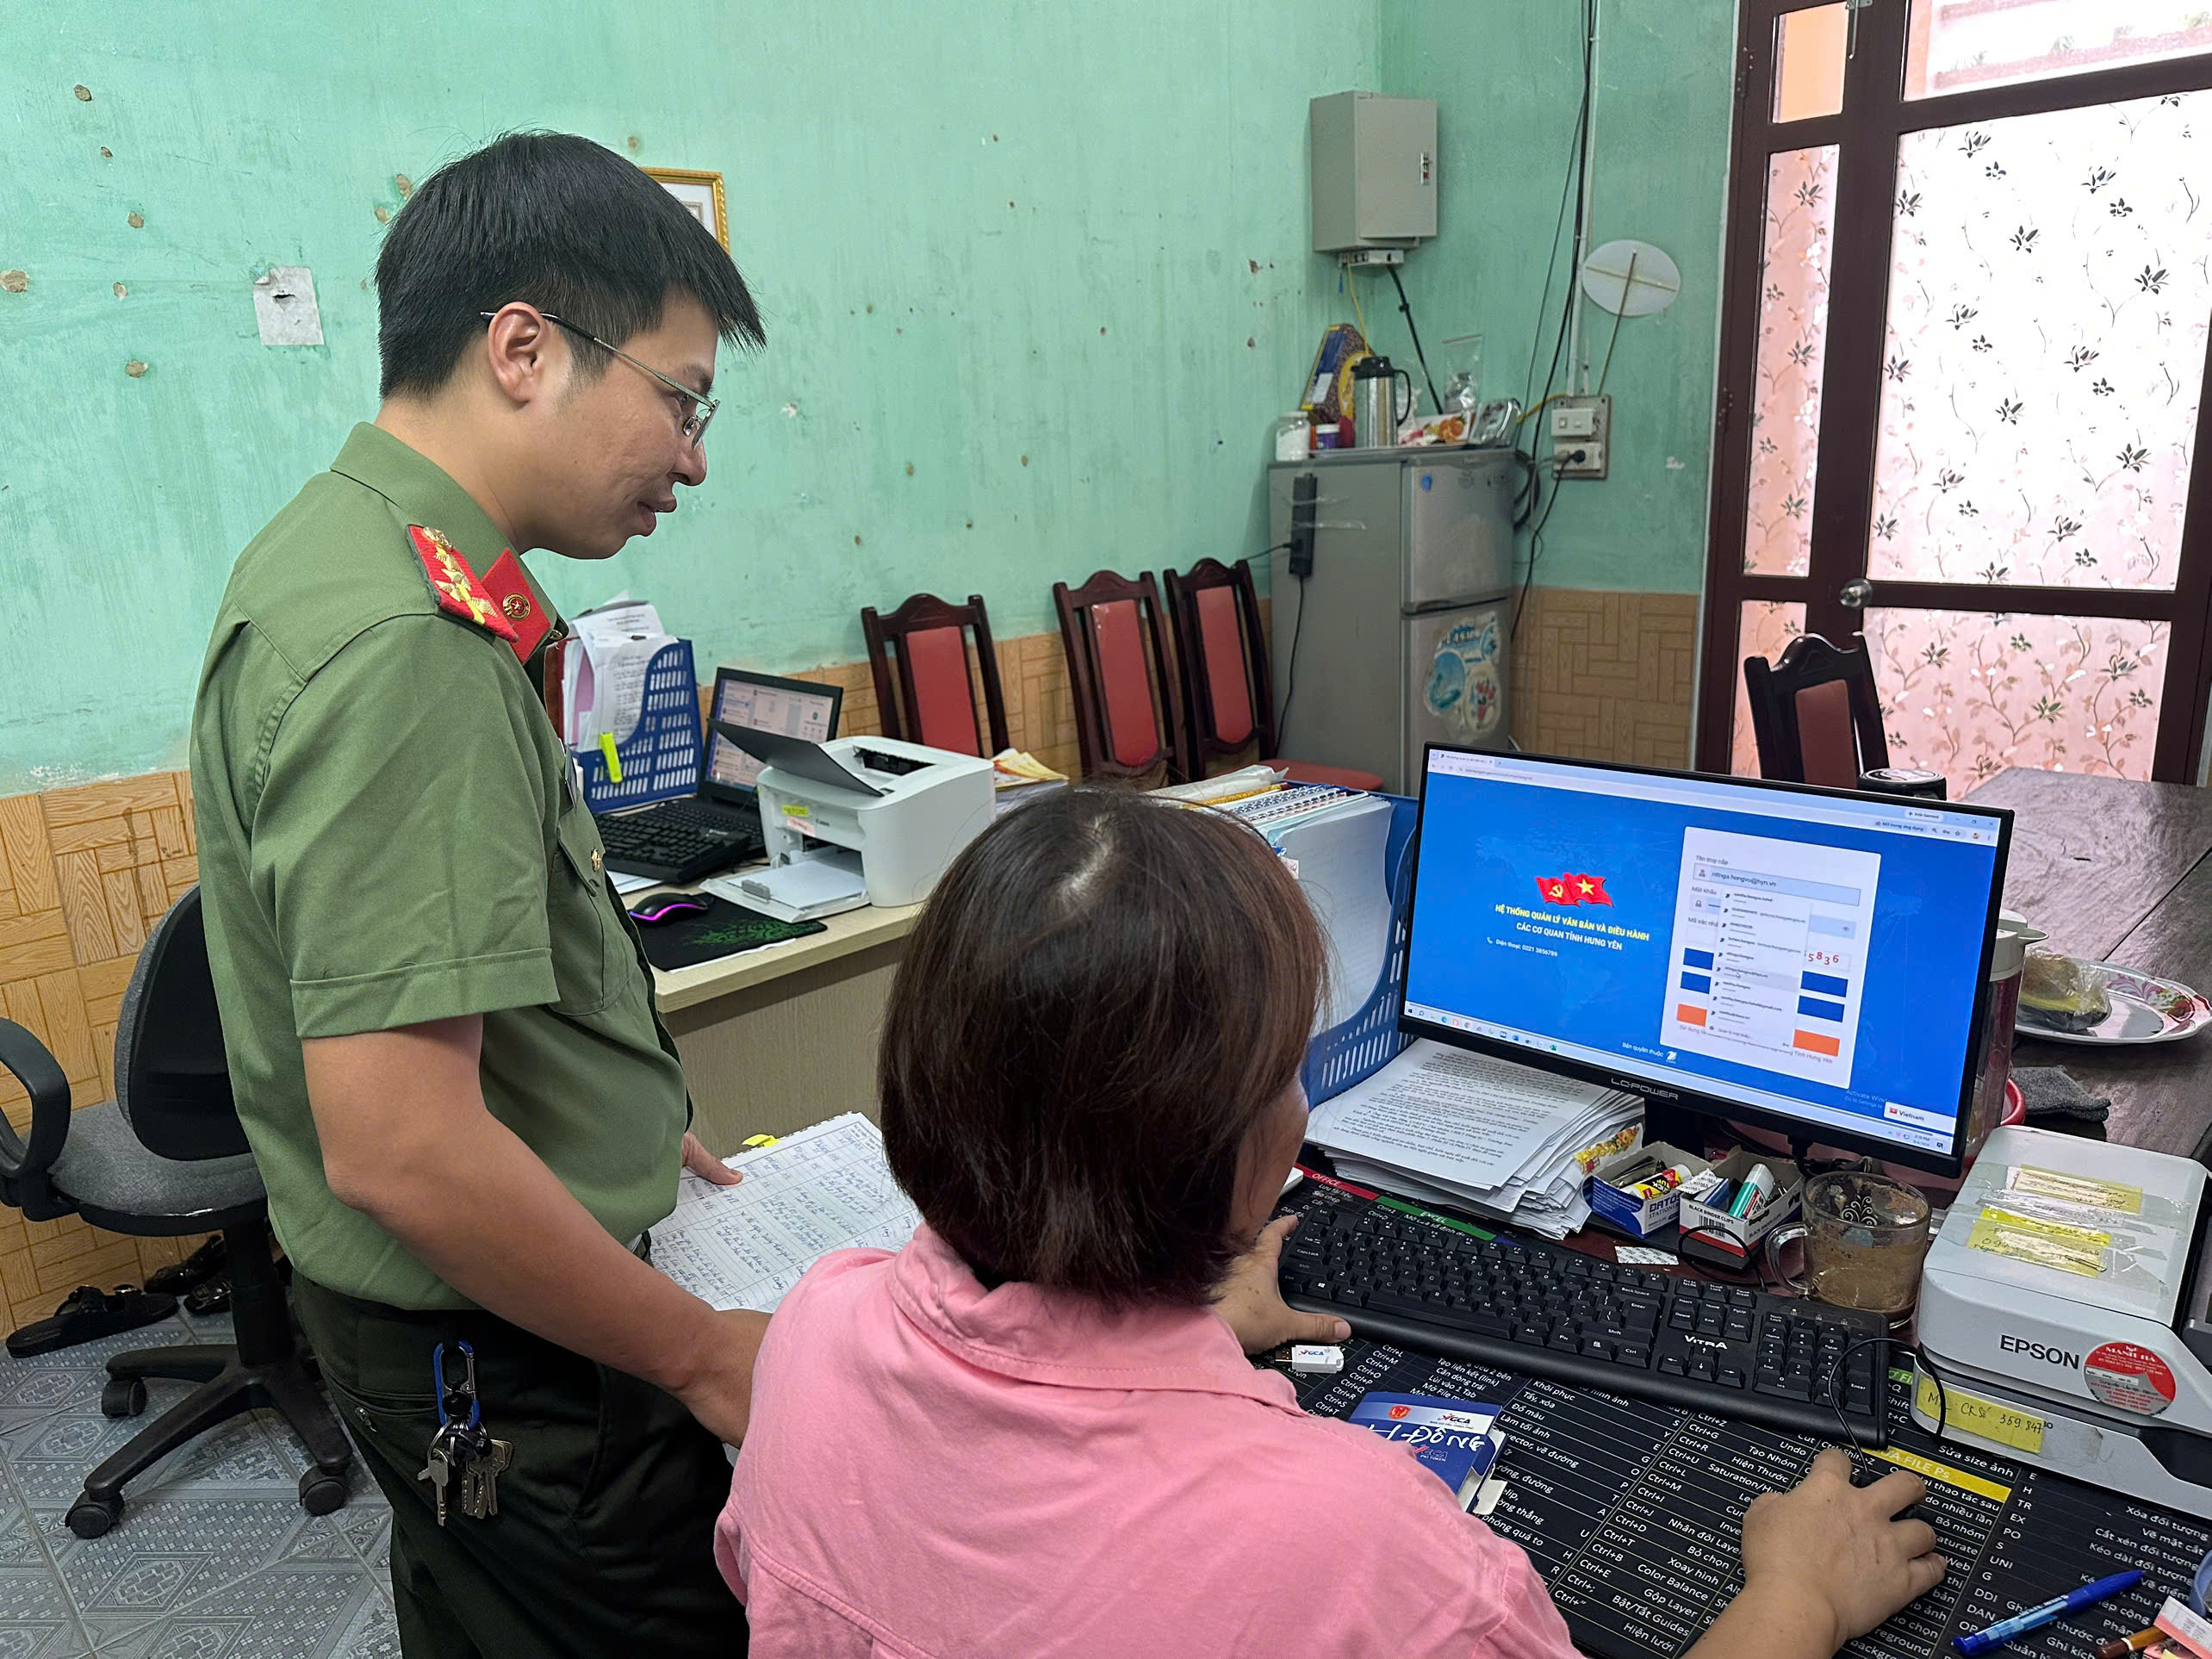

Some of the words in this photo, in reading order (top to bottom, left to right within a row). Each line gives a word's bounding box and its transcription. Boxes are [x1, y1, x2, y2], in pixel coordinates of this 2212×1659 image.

[1507, 905, 1531, 918] THỐNG
[1552, 914, 1561, 924] LÝ
[1562, 916, 1578, 928] VĂN
[1596, 922, 1606, 933] VÀ
[1626, 928, 1650, 941] HÀNH
[1516, 921, 1532, 932] CÁC
[1544, 928, 1564, 940] QUAN
[1583, 935, 1606, 948] HƯNG
[1607, 939, 1623, 951] YÊN
[1898, 1109, 1924, 1122] Vietnam
[1311, 1172, 1343, 1187] OFFICE
[1420, 1210, 1446, 1224] EXCEL
[1372, 1350, 1399, 1365] Ctrl+M
[1382, 1344, 1404, 1358] Ctrl+L
[1998, 1333, 2081, 1371] EPSON
[1365, 1357, 1391, 1371] Ctrl+N
[1437, 1357, 1451, 1368] Tạo
[1478, 1374, 1501, 1388] (link)
[1340, 1378, 1365, 1394] Ctrl+Q
[1349, 1371, 1374, 1385] Ctrl+P
[1324, 1394, 1349, 1408] Ctrl+S
[1332, 1386, 1357, 1401] Ctrl+R
[1436, 1388, 1452, 1398] File
[1462, 1388, 1477, 1399] Tab
[1538, 1397, 1556, 1409] xóa
[1552, 1388, 1576, 1403] phục
[1315, 1401, 1341, 1415] Ctrl+T
[1524, 1407, 1546, 1421] màu
[1500, 1413, 1519, 1426] Làm
[1519, 1420, 1533, 1432] tối
[1532, 1426, 1551, 1440] ảnh
[1698, 1412, 1728, 1428] Ctrl+Z
[1688, 1423, 1720, 1439] Ctrl+G
[1779, 1440, 1807, 1457] Undo
[1547, 1447, 1580, 1469] đường
[1679, 1435, 1710, 1452] Ctrl+R
[1748, 1445, 1767, 1459] Tạo
[1766, 1453, 1799, 1470] Nhóm
[1937, 1445, 1964, 1461] Sửa
[1963, 1452, 1989, 1469] size
[1989, 1462, 2016, 1478] ảnh
[1658, 1460, 1687, 1477] Ctrl+L
[1668, 1447, 1700, 1464] Ctrl+U
[1730, 1456, 1755, 1471] Hiện
[1755, 1464, 1791, 1484] Thước
[1903, 1455, 1932, 1472] FILE
[1932, 1466, 1952, 1481] Ps
[1521, 1474, 1555, 1494] đường
[1647, 1473, 1682, 1492] Ctrl+M
[1934, 1482, 1960, 1497] thao
[1960, 1490, 1979, 1504] tác
[1979, 1500, 2001, 1512] sau
[1515, 1507, 1544, 1526] thẳng
[1625, 1500, 1655, 1518] Ctrl+J
[1941, 1501, 1974, 1520] nhiều
[1973, 1511, 1993, 1526] lần
[1614, 1513, 1648, 1533] Ctrl+D
[1667, 1518, 1696, 1537] Nhân
[1695, 1529, 1712, 1544] đôi
[1935, 1516, 1951, 1528] Bỏ
[1951, 1522, 1986, 1542] nhóm
[2016, 1498, 2034, 1511] TR
[2125, 1505, 2148, 1520] Xóa
[2149, 1513, 2171, 1527] đối
[2171, 1521, 2210, 1543] tượng
[1512, 1527, 1532, 1542] quá
[1532, 1535, 1544, 1547] to
[1936, 1535, 1979, 1556] aturate
[2010, 1513, 2027, 1525] EX
[2158, 1533, 2184, 1549] mặt
[2184, 1542, 2205, 1557] cắt
[1603, 1528, 1636, 1548] Ctrl+T
[1687, 1544, 1702, 1558] Bỏ
[1702, 1552, 1731, 1571] chọn
[2003, 1527, 2022, 1540] PO
[2094, 1527, 2115, 1542] Cắt
[2139, 1542, 2161, 1557] đối
[2161, 1550, 2200, 1572] tượng
[2088, 1541, 2112, 1556] Kéo
[2113, 1550, 2134, 1565] dài
[2134, 1557, 2155, 1571] đối
[1591, 1543, 1625, 1563] Ctrl+B
[1667, 1556, 1696, 1575] Xoay
[1695, 1568, 1720, 1587] hình
[1944, 1556, 1973, 1572] Web
[1988, 1555, 2015, 1570] UNI
[1578, 1558, 1612, 1579] Ctrl+E
[1637, 1563, 1667, 1581] Color
[1666, 1575, 1710, 1602] Balance
[1566, 1573, 1596, 1594] Ctrl+;
[1643, 1588, 1667, 1606] Gộp
[1667, 1598, 1699, 1619] Layer
[1931, 1588, 1956, 1605] bản
[1973, 1588, 1999, 1603] DDI
[2129, 1590, 2153, 1607] thu
[1612, 1594, 1650, 1620] Bật/Tắt
[1651, 1613, 1691, 1637] Guides
[1922, 1603, 1948, 1623] ảnh
[1966, 1603, 1998, 1622] DAN
[2119, 1606, 2152, 1626] cộng
[1622, 1621, 1650, 1641] Hiện
[1650, 1634, 1676, 1654] lưới
[1907, 1620, 1940, 1641] chọn
[2055, 1619, 2095, 1643] thước
[1873, 1626, 1932, 1658] reground
[2045, 1636, 2069, 1652] Ghi
